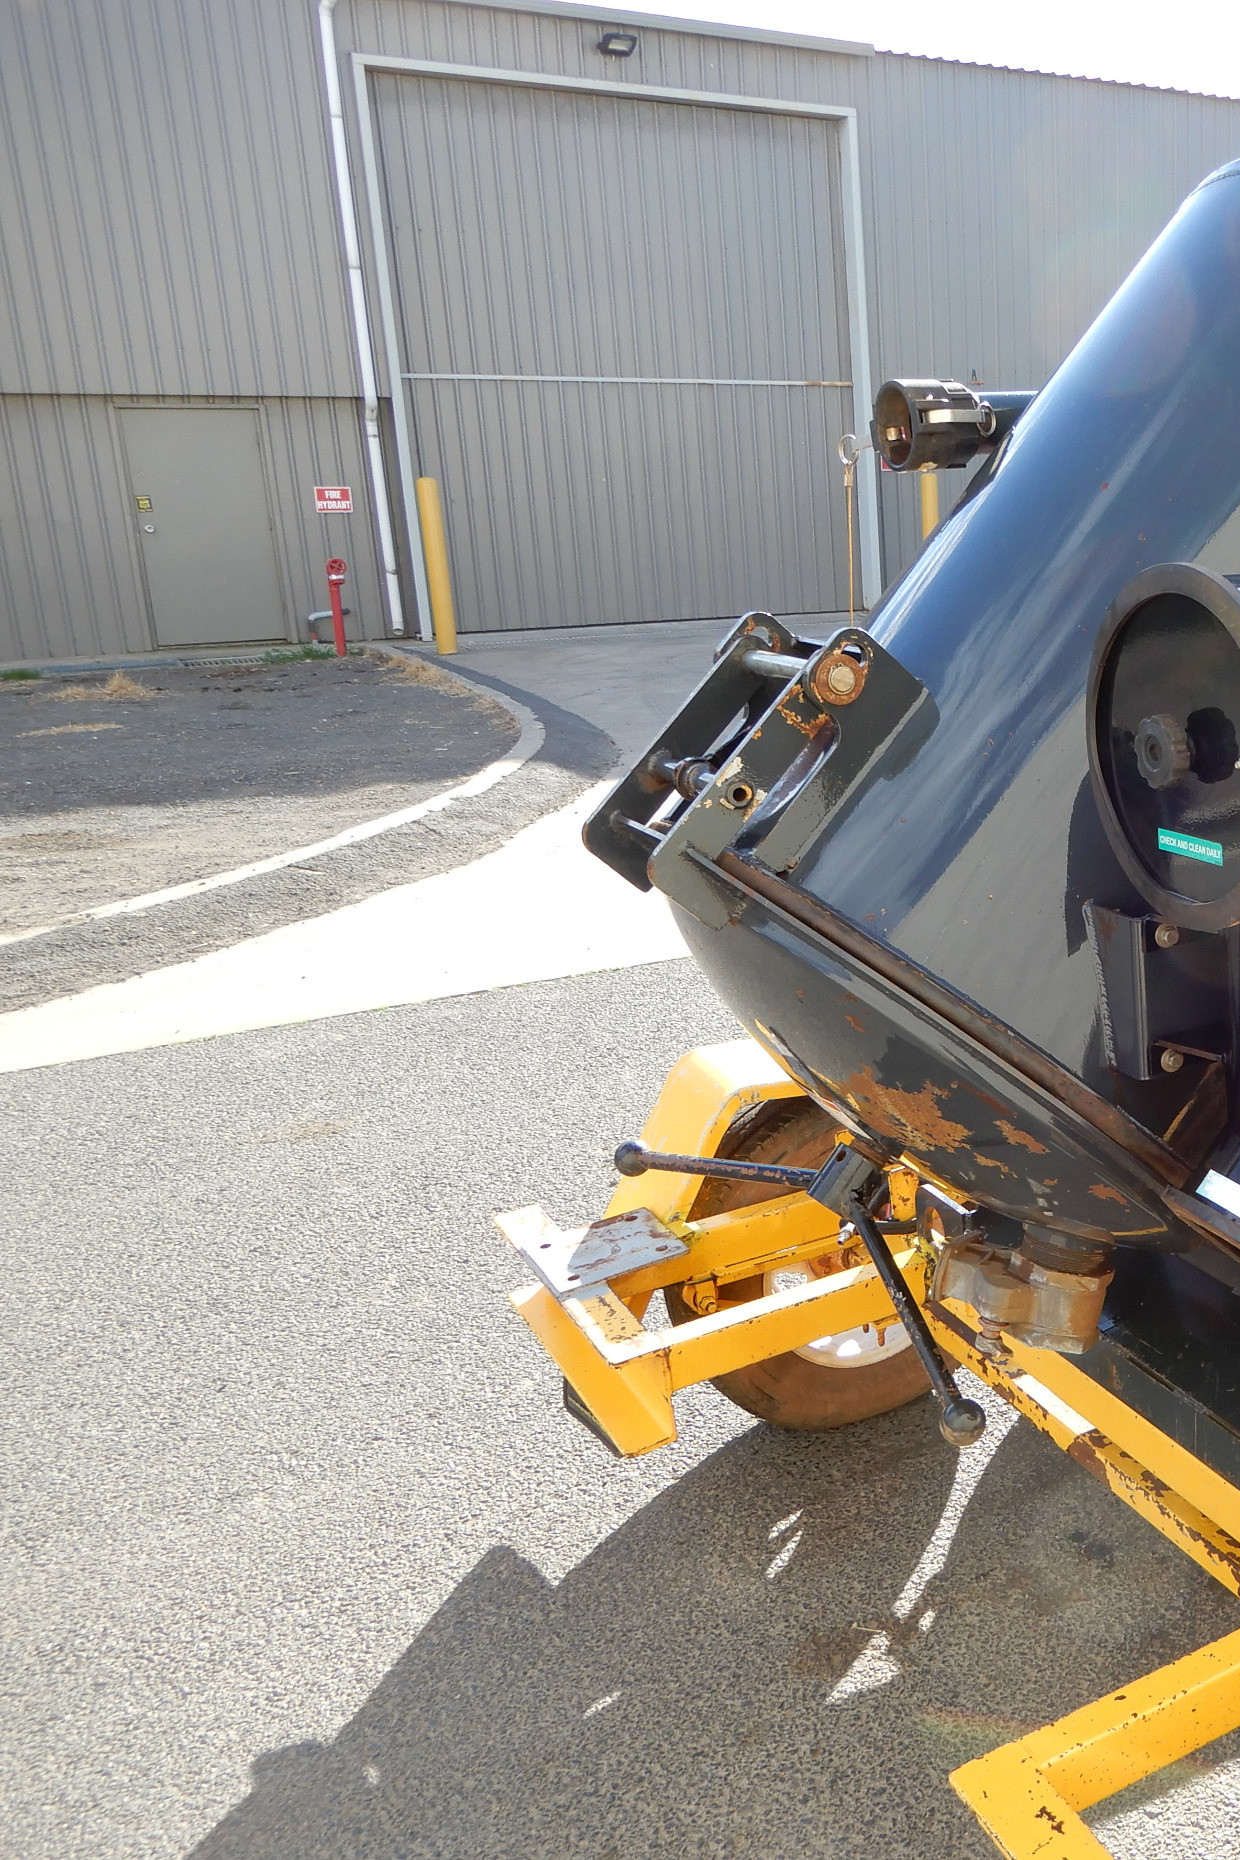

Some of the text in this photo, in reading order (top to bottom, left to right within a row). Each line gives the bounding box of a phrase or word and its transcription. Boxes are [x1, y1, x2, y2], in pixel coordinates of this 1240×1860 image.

[324, 490, 342, 499] FIRE
[317, 500, 351, 510] HYDRANT
[1160, 835, 1221, 859] CHECK AND CLEAN DAILY
